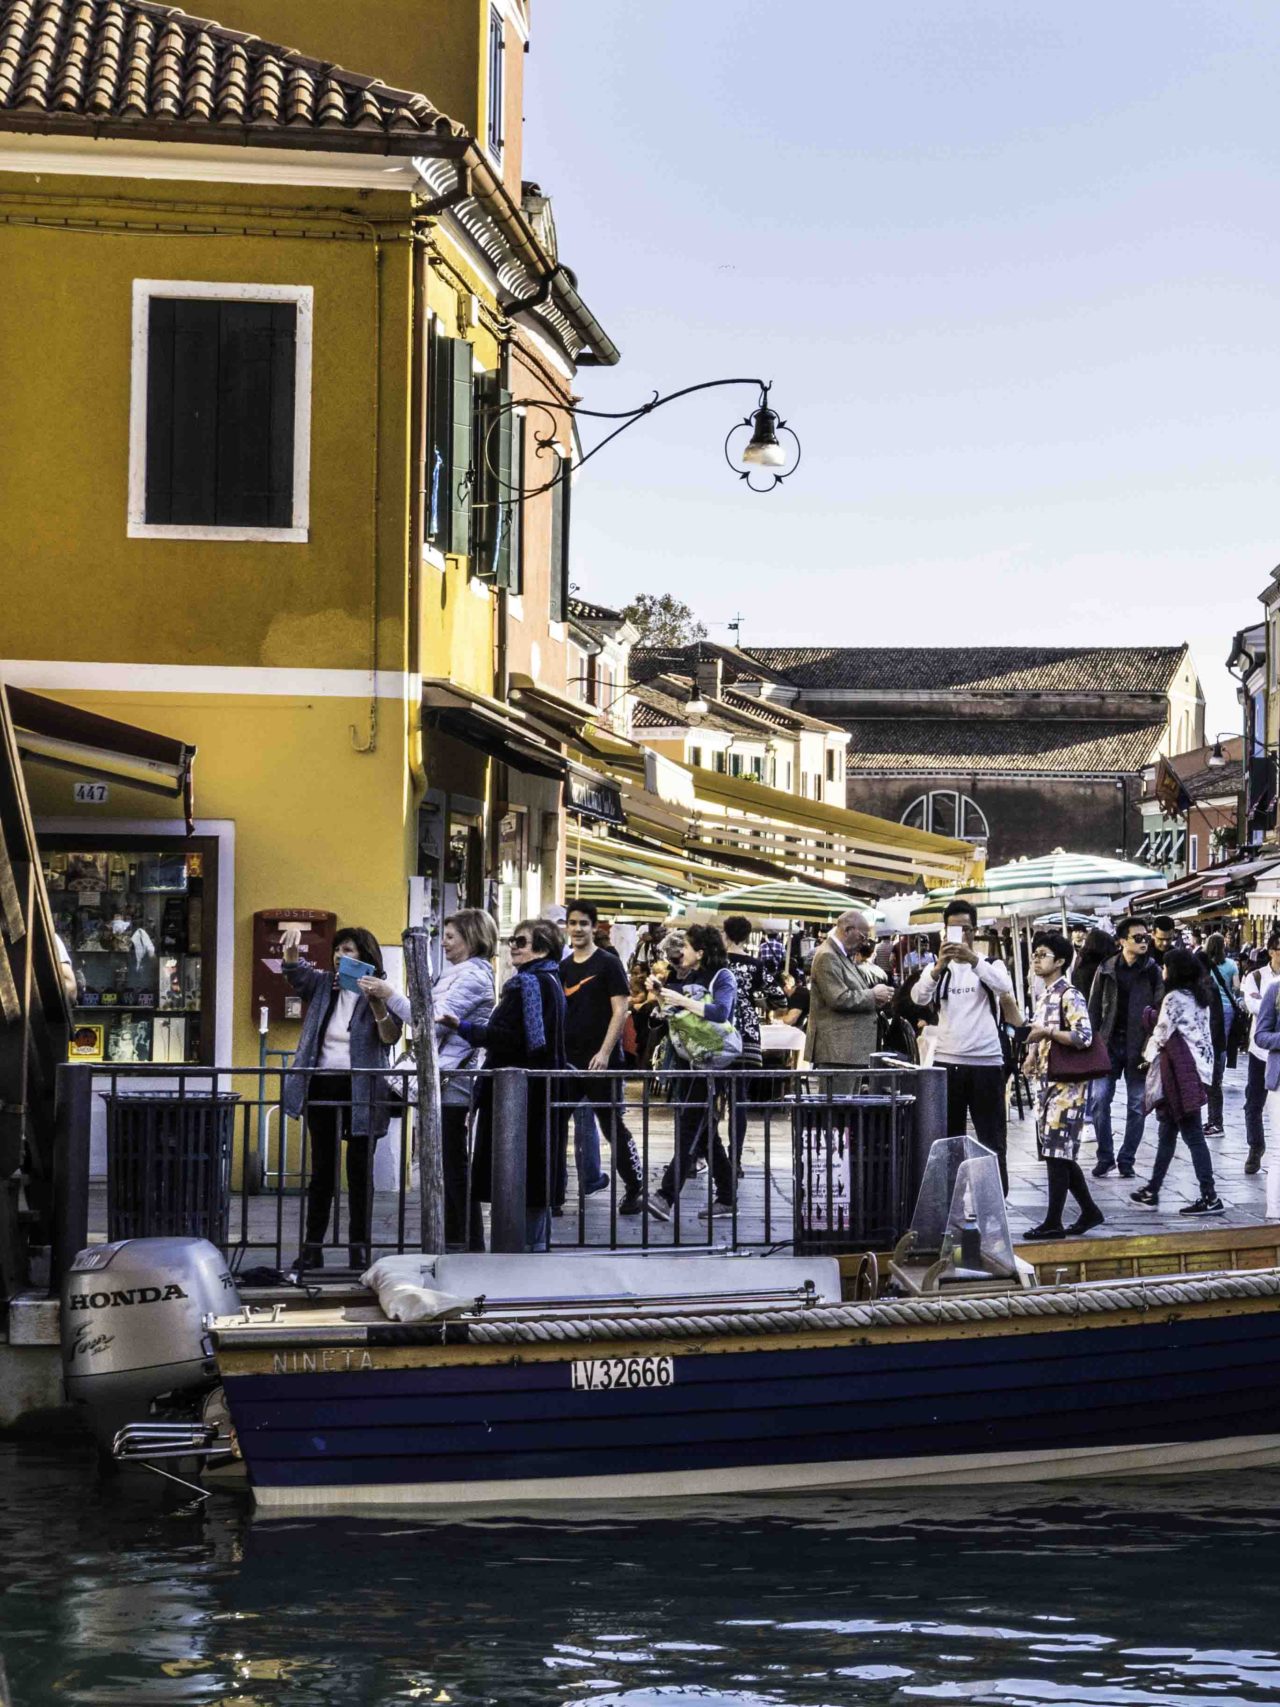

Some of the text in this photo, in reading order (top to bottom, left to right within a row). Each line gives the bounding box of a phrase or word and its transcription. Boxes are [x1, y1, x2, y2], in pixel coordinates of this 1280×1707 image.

[76, 785, 106, 800] 447
[275, 910, 316, 918] POSTE
[70, 1284, 188, 1311] HONDA
[273, 1349, 373, 1373] NINETA
